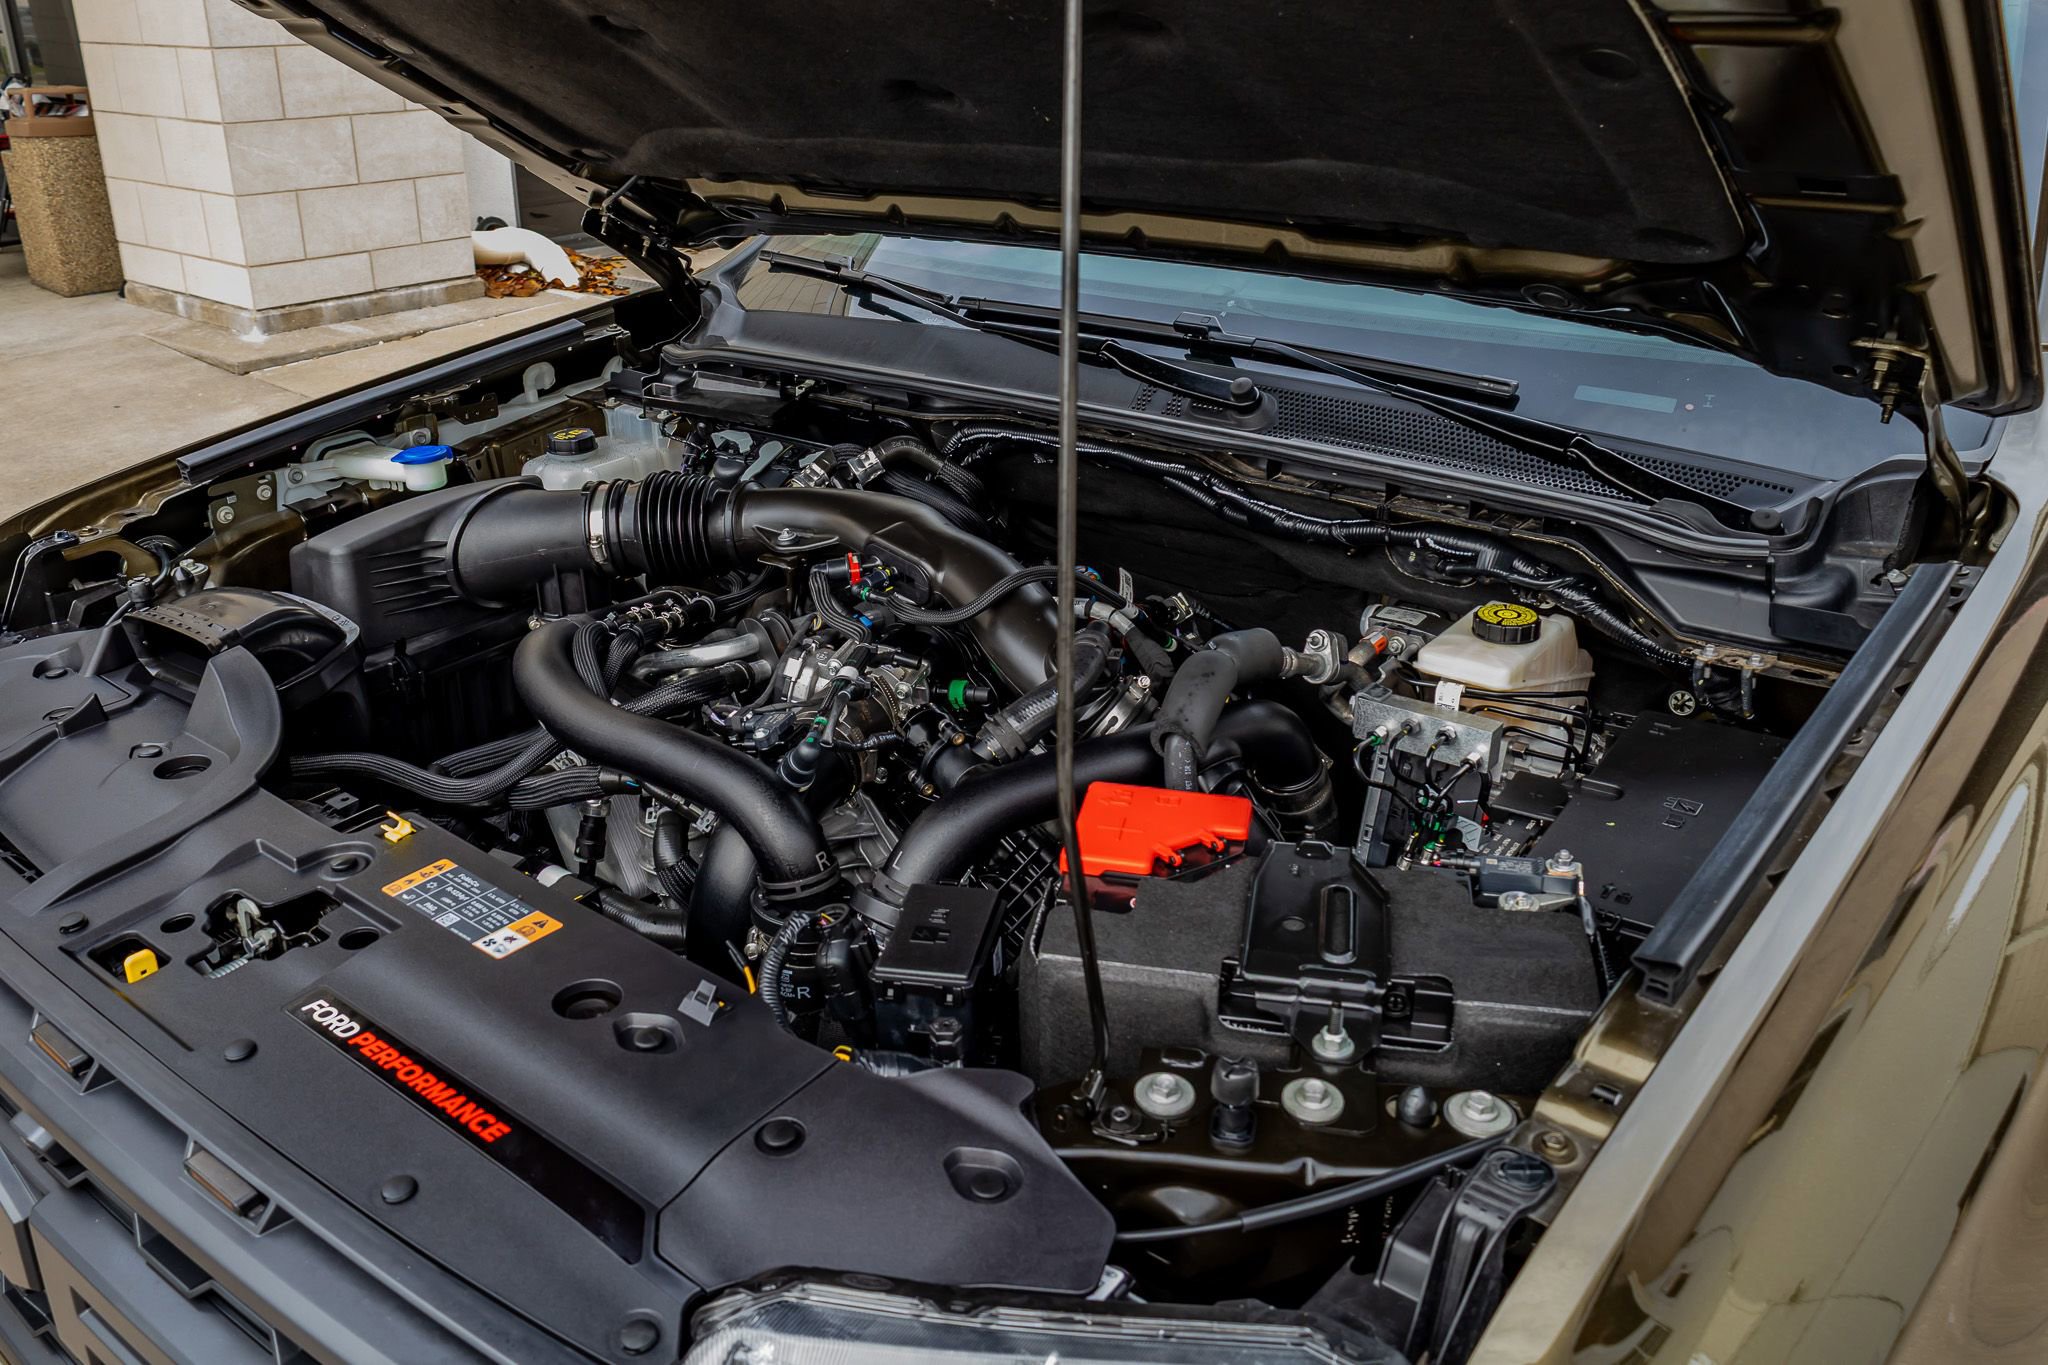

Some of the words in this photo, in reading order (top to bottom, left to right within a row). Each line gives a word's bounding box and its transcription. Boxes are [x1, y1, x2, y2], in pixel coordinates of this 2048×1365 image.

[815, 851, 831, 871] R
[892, 850, 903, 870] L
[797, 986, 811, 1000] R
[301, 999, 361, 1038] FORD
[347, 1031, 512, 1142] PERFORMANCE
